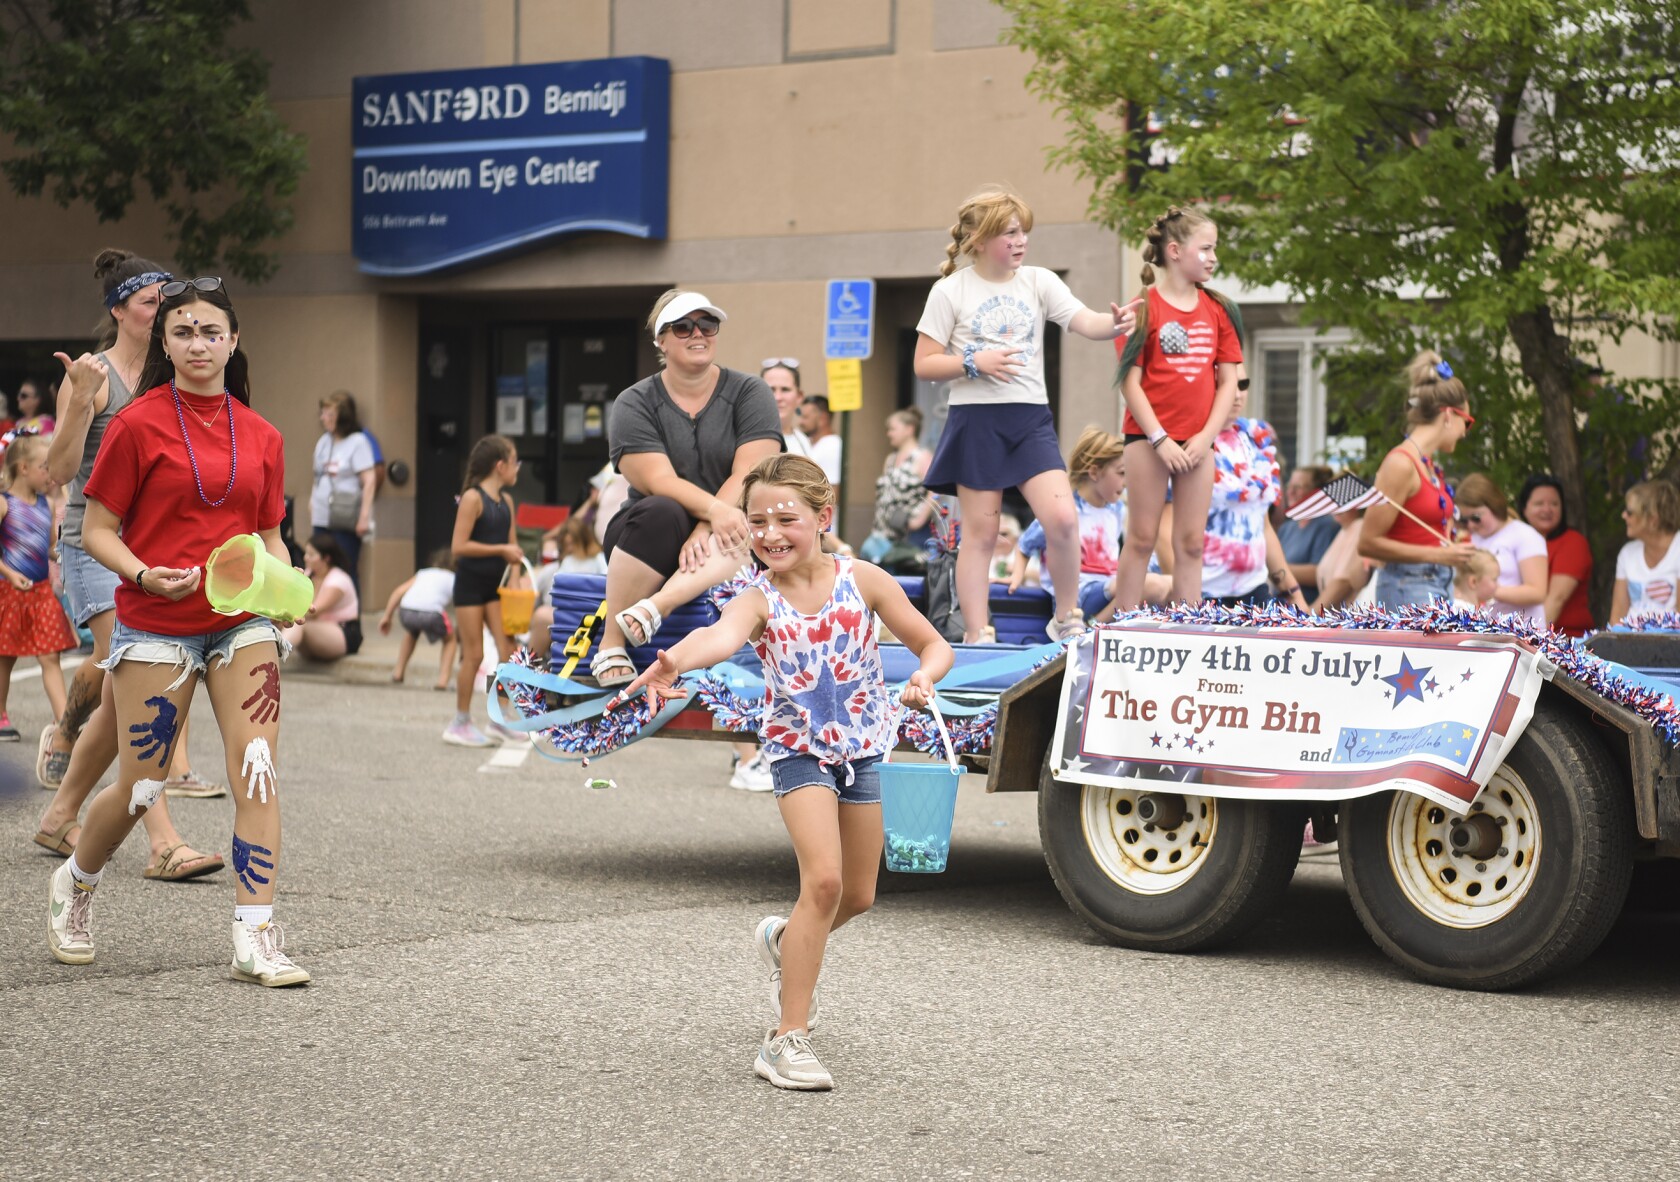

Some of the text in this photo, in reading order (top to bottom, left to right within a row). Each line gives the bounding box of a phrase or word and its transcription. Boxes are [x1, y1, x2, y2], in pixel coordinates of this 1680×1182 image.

[362, 80, 627, 127] SANFORD Bemidji
[362, 156, 600, 194] Downtown Eye Center
[427, 212, 448, 226] Ave
[1101, 638, 1381, 686] Happy 4th of July!
[1197, 678, 1244, 695] From:
[1101, 689, 1321, 735] The Gym Bin
[1300, 748, 1333, 763] and
[1415, 734, 1442, 750] Club
